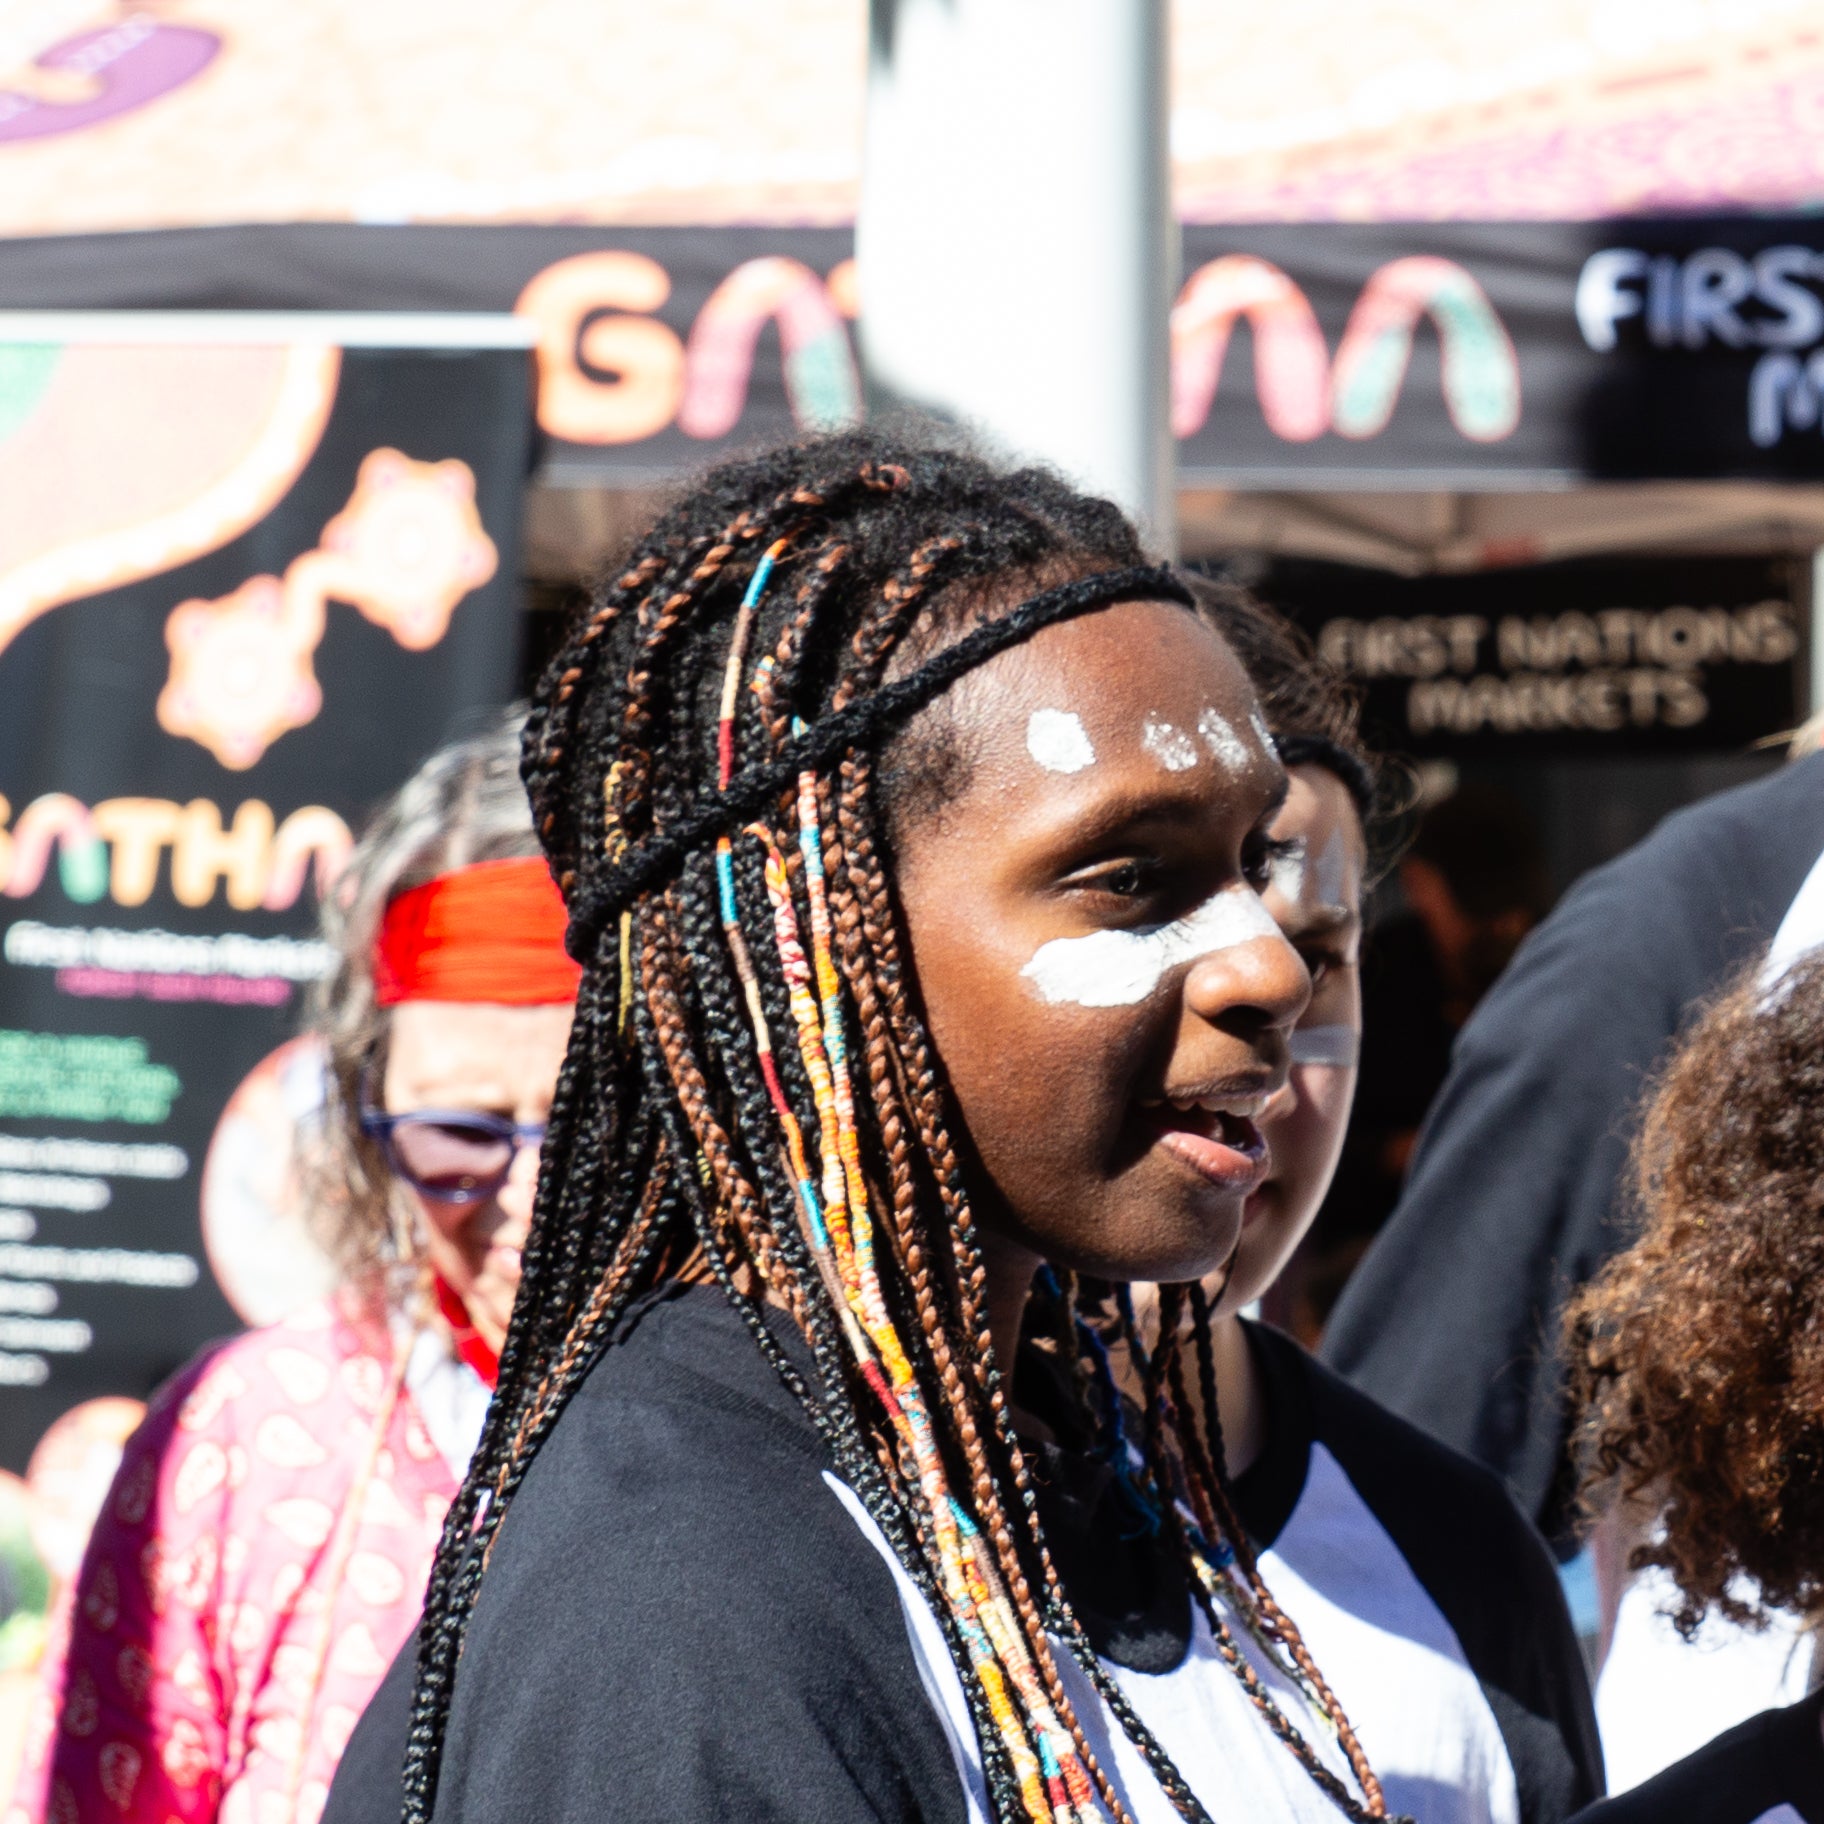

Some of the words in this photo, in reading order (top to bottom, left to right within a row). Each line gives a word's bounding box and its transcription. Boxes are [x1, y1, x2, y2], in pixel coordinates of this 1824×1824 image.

[1318, 616, 1491, 678] FIRST
[1497, 601, 1798, 671] NATIONS
[1407, 668, 1707, 735] MARKETS
